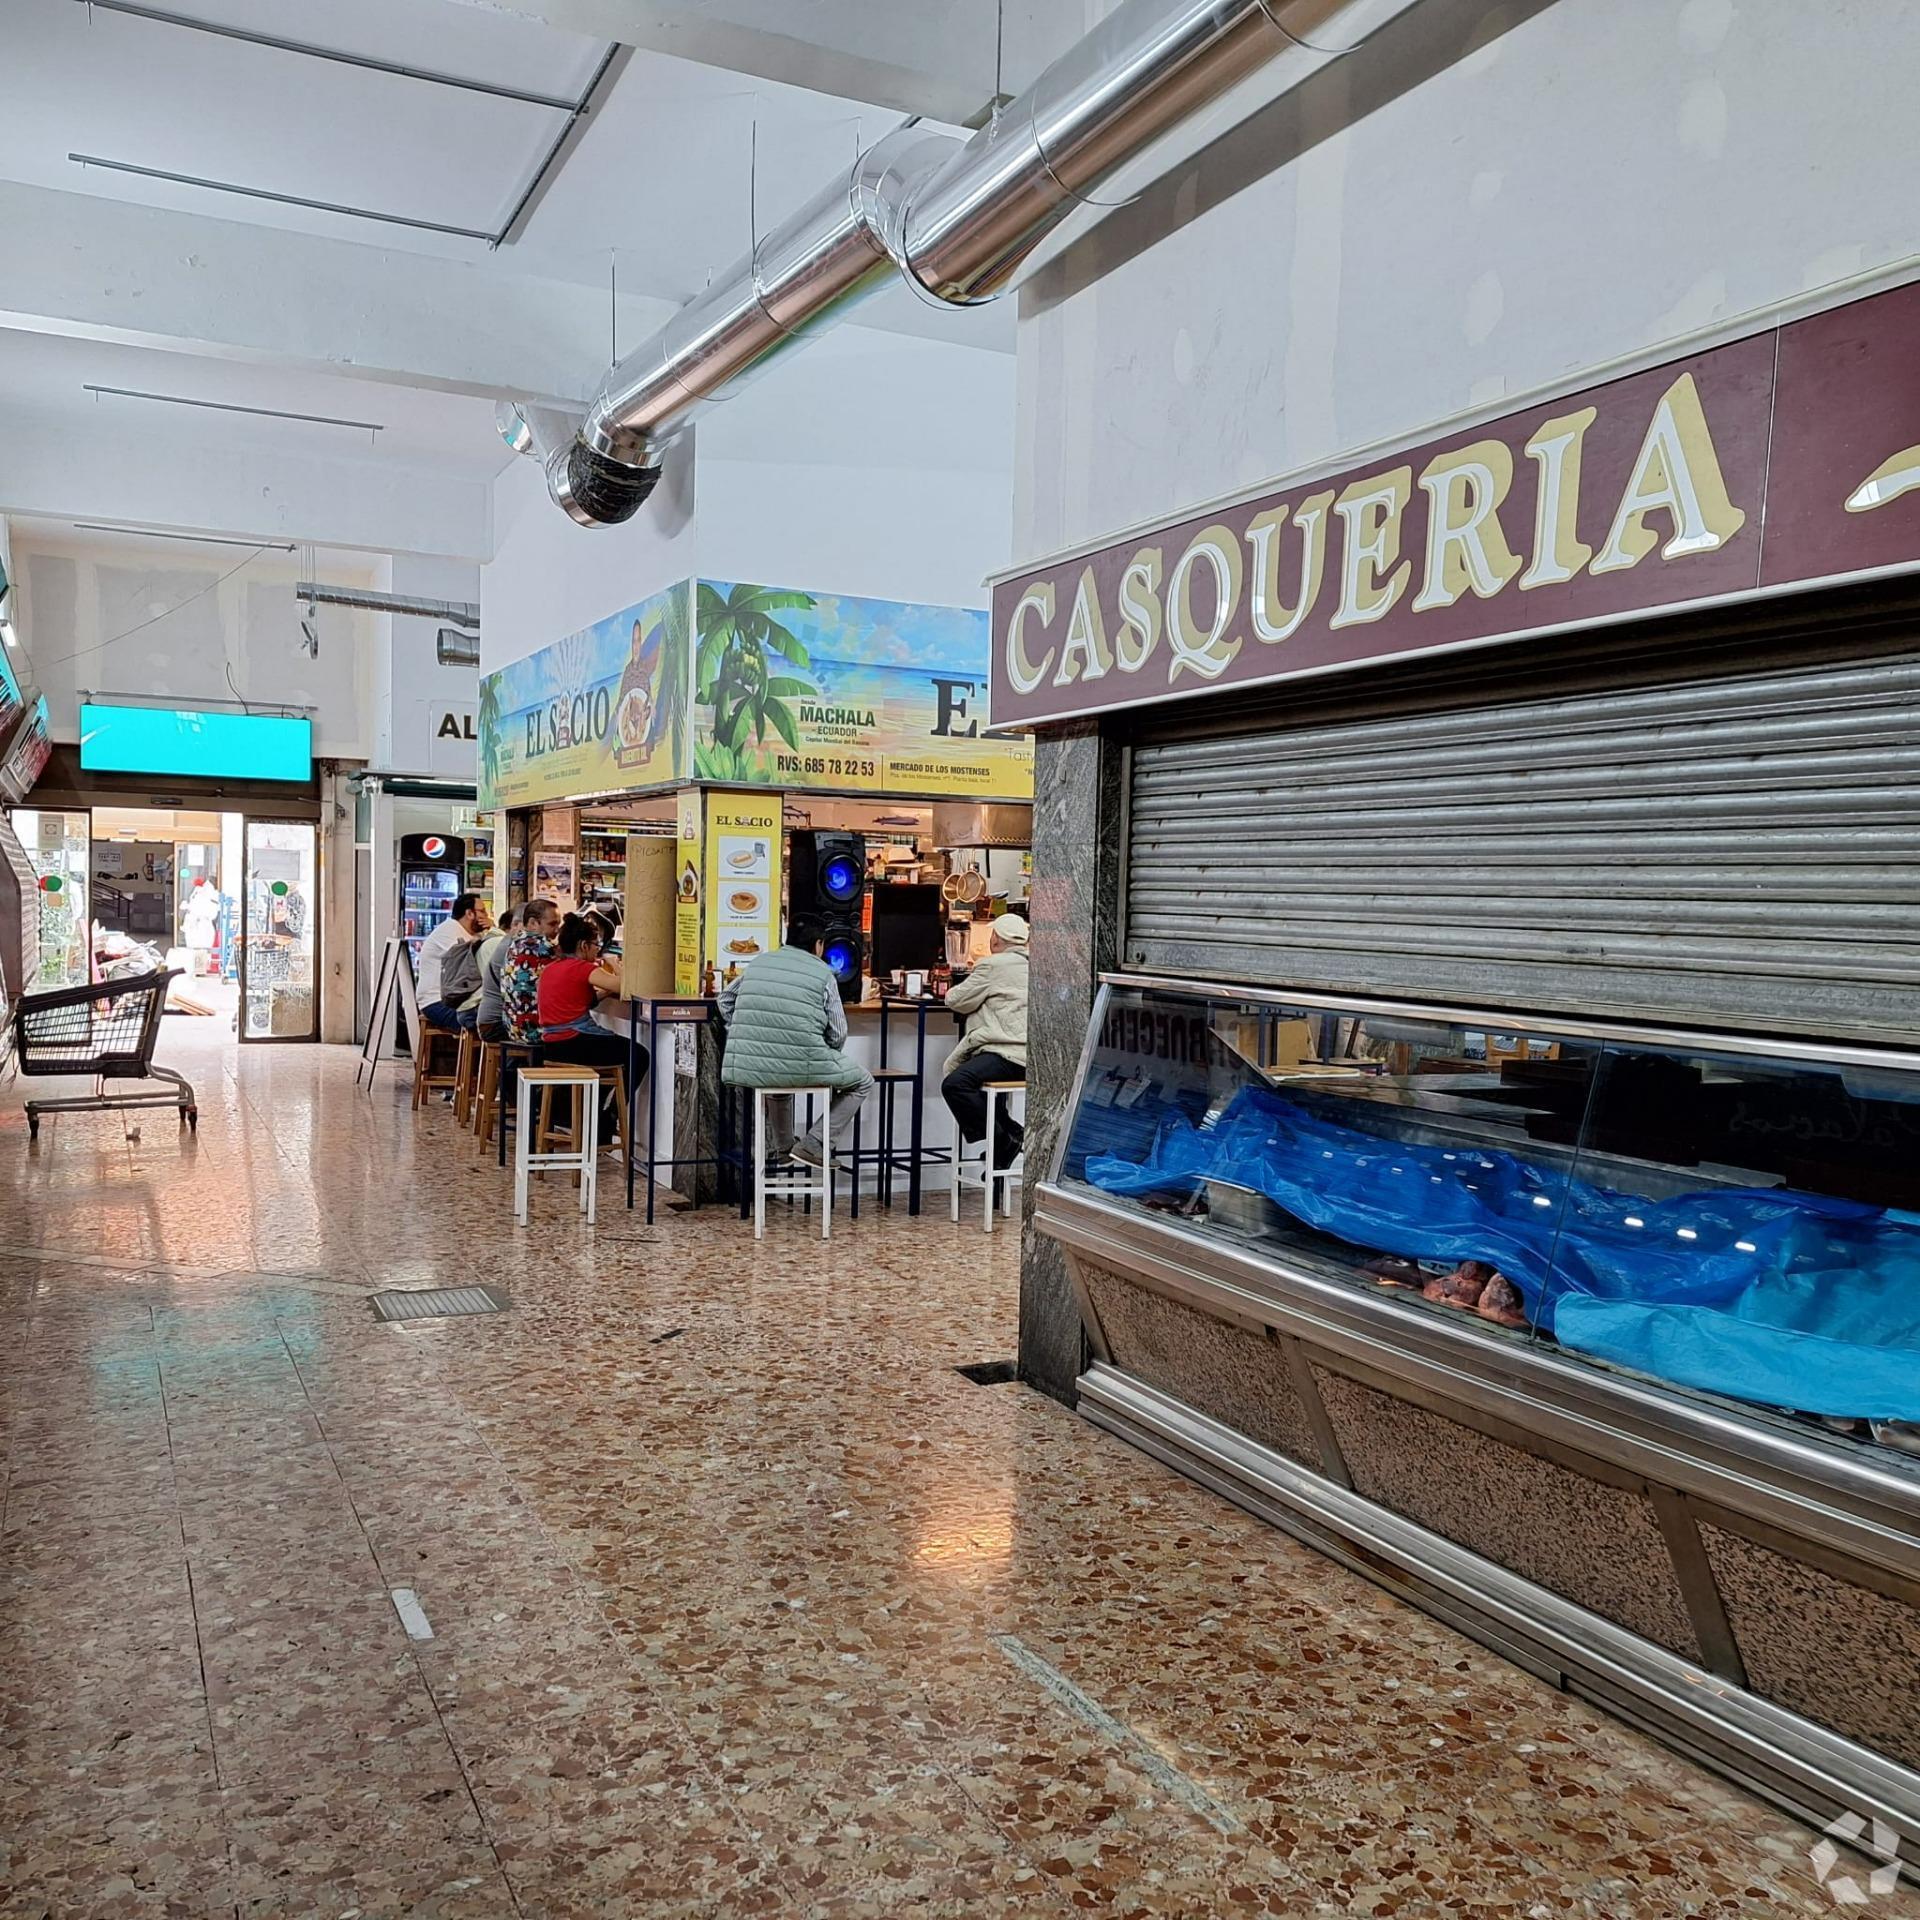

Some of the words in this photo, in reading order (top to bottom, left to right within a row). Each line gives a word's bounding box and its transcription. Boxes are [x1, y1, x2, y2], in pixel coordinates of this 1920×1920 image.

[1006, 371, 1746, 697] CASQUERIA
[799, 705, 876, 728] MACHALA
[930, 678, 1025, 741] E
[525, 708, 546, 758] EL
[549, 686, 610, 752] SCIO
[777, 755, 802, 772] RVS:
[804, 756, 825, 774] 685
[828, 758, 842, 774] 78
[844, 759, 858, 776] 22
[860, 760, 875, 777] 53
[889, 762, 924, 772] MERCADO
[924, 764, 934, 773] DE
[935, 765, 949, 774] LOS
[949, 766, 990, 776] MOSTENSES
[716, 815, 732, 826] EL
[734, 815, 773, 828] SCIO
